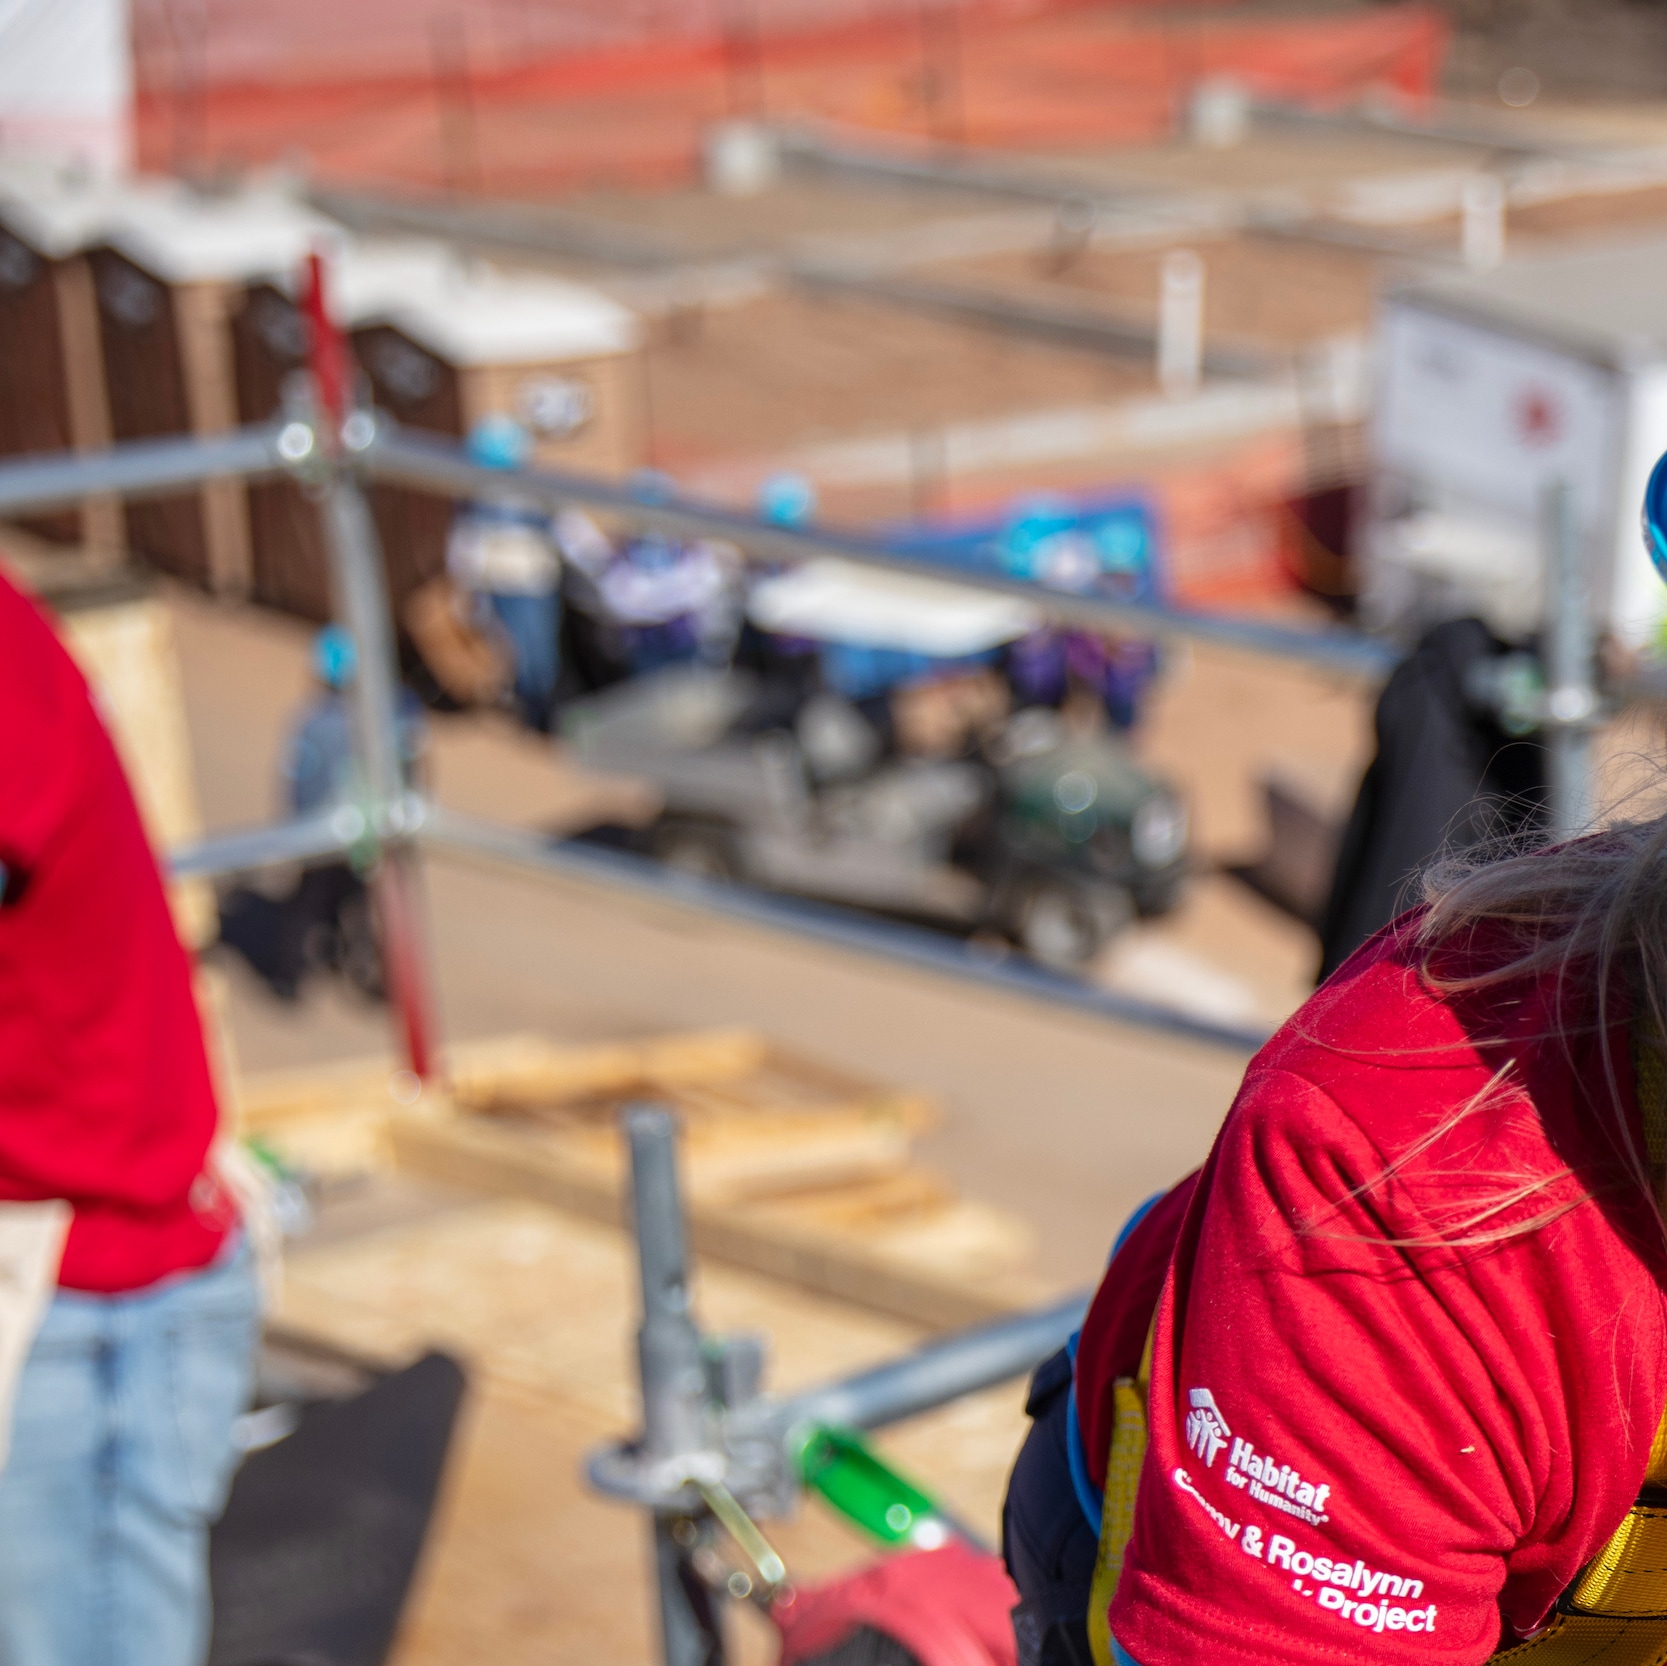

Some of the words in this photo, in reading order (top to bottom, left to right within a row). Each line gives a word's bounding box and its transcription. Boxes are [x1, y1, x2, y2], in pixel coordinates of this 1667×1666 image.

[1224, 1465, 1249, 1490] for
[1229, 1436, 1331, 1513] Habitat
[1240, 1524, 1265, 1560] &
[1267, 1533, 1425, 1600] Rosalynn
